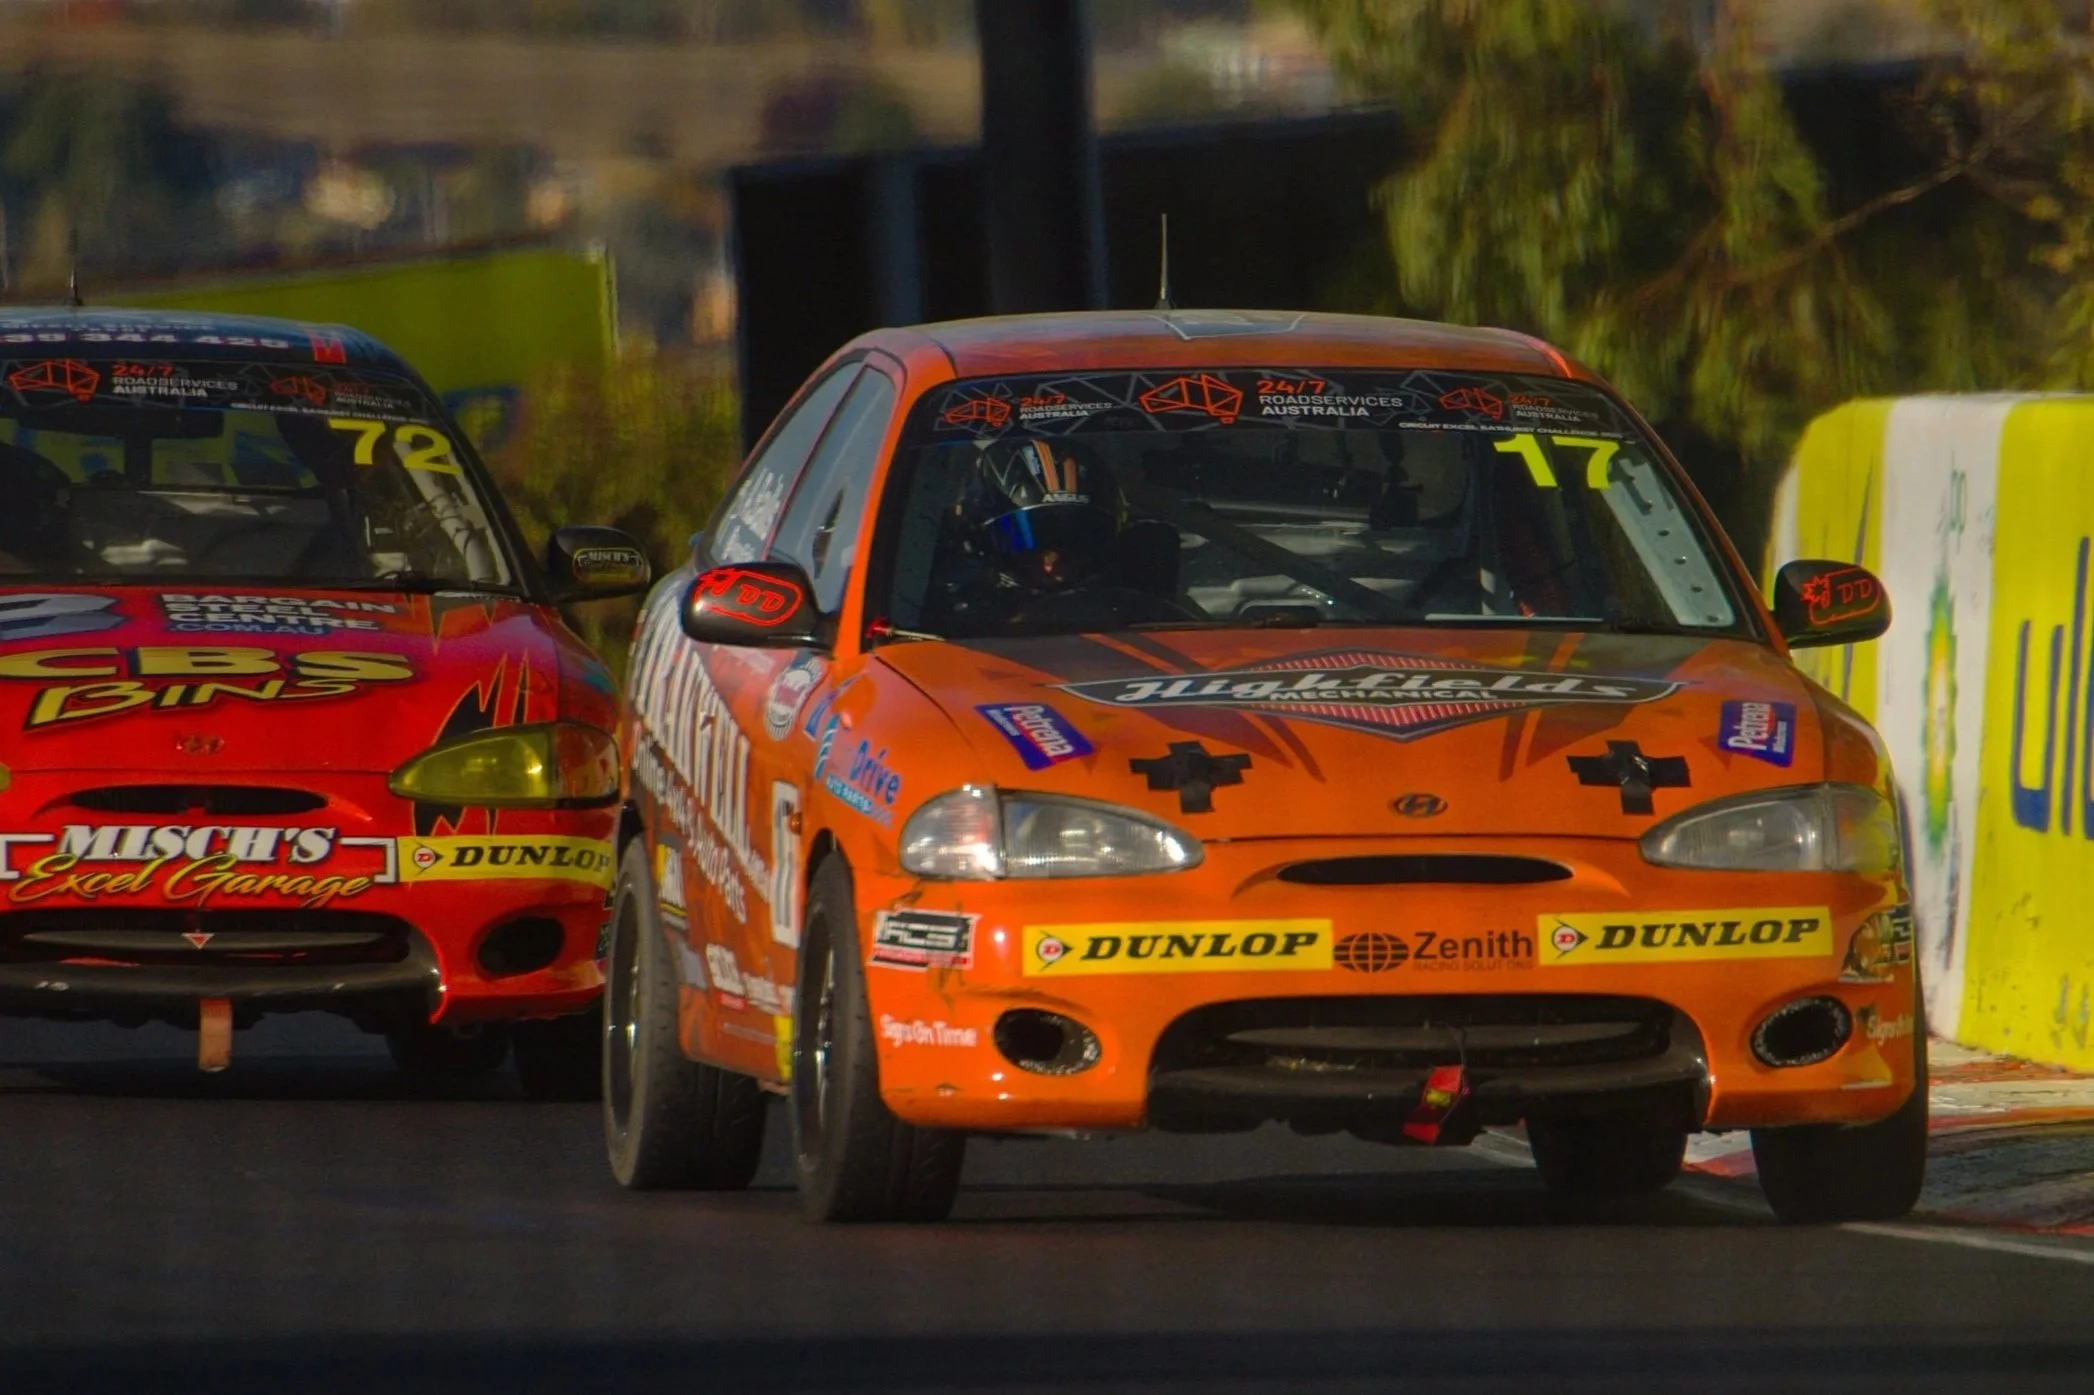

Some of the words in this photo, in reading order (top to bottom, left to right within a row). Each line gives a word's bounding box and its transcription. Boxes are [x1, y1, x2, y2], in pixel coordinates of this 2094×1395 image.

[112, 363, 176, 377] 24/7
[112, 376, 239, 391] ROADSERVICES
[112, 385, 209, 398] AUSTRALIA
[1256, 379, 1327, 395] 24/7
[1019, 402, 1113, 413] ROADSERVICES
[1020, 393, 1066, 406] 24/7
[1259, 394, 1403, 408] ROADSERVICES
[1019, 410, 1089, 420] AUSTRALIA
[1262, 405, 1370, 418] AUSTRALIA
[1515, 410, 1582, 422] AUSTRALIA
[328, 418, 464, 477] 72
[1492, 432, 1621, 491] 17
[160, 593, 397, 614] BARGAIN
[164, 603, 329, 617] STEEL
[168, 612, 380, 631] CENTRE
[170, 622, 325, 636] .COM.AU
[0, 646, 414, 681] CBS
[1115, 673, 1638, 701] Highfields
[1269, 690, 1499, 701] MECHANICAL
[25, 678, 361, 731] BINS
[58, 824, 337, 863] MISCH'S
[450, 845, 611, 873] DUNLOP
[9, 853, 168, 902] Excel
[163, 853, 373, 909] Garage
[1595, 918, 1821, 951] DUNLOP
[1081, 932, 1319, 961] DUNLOP
[1412, 930, 1533, 960] Zenith
